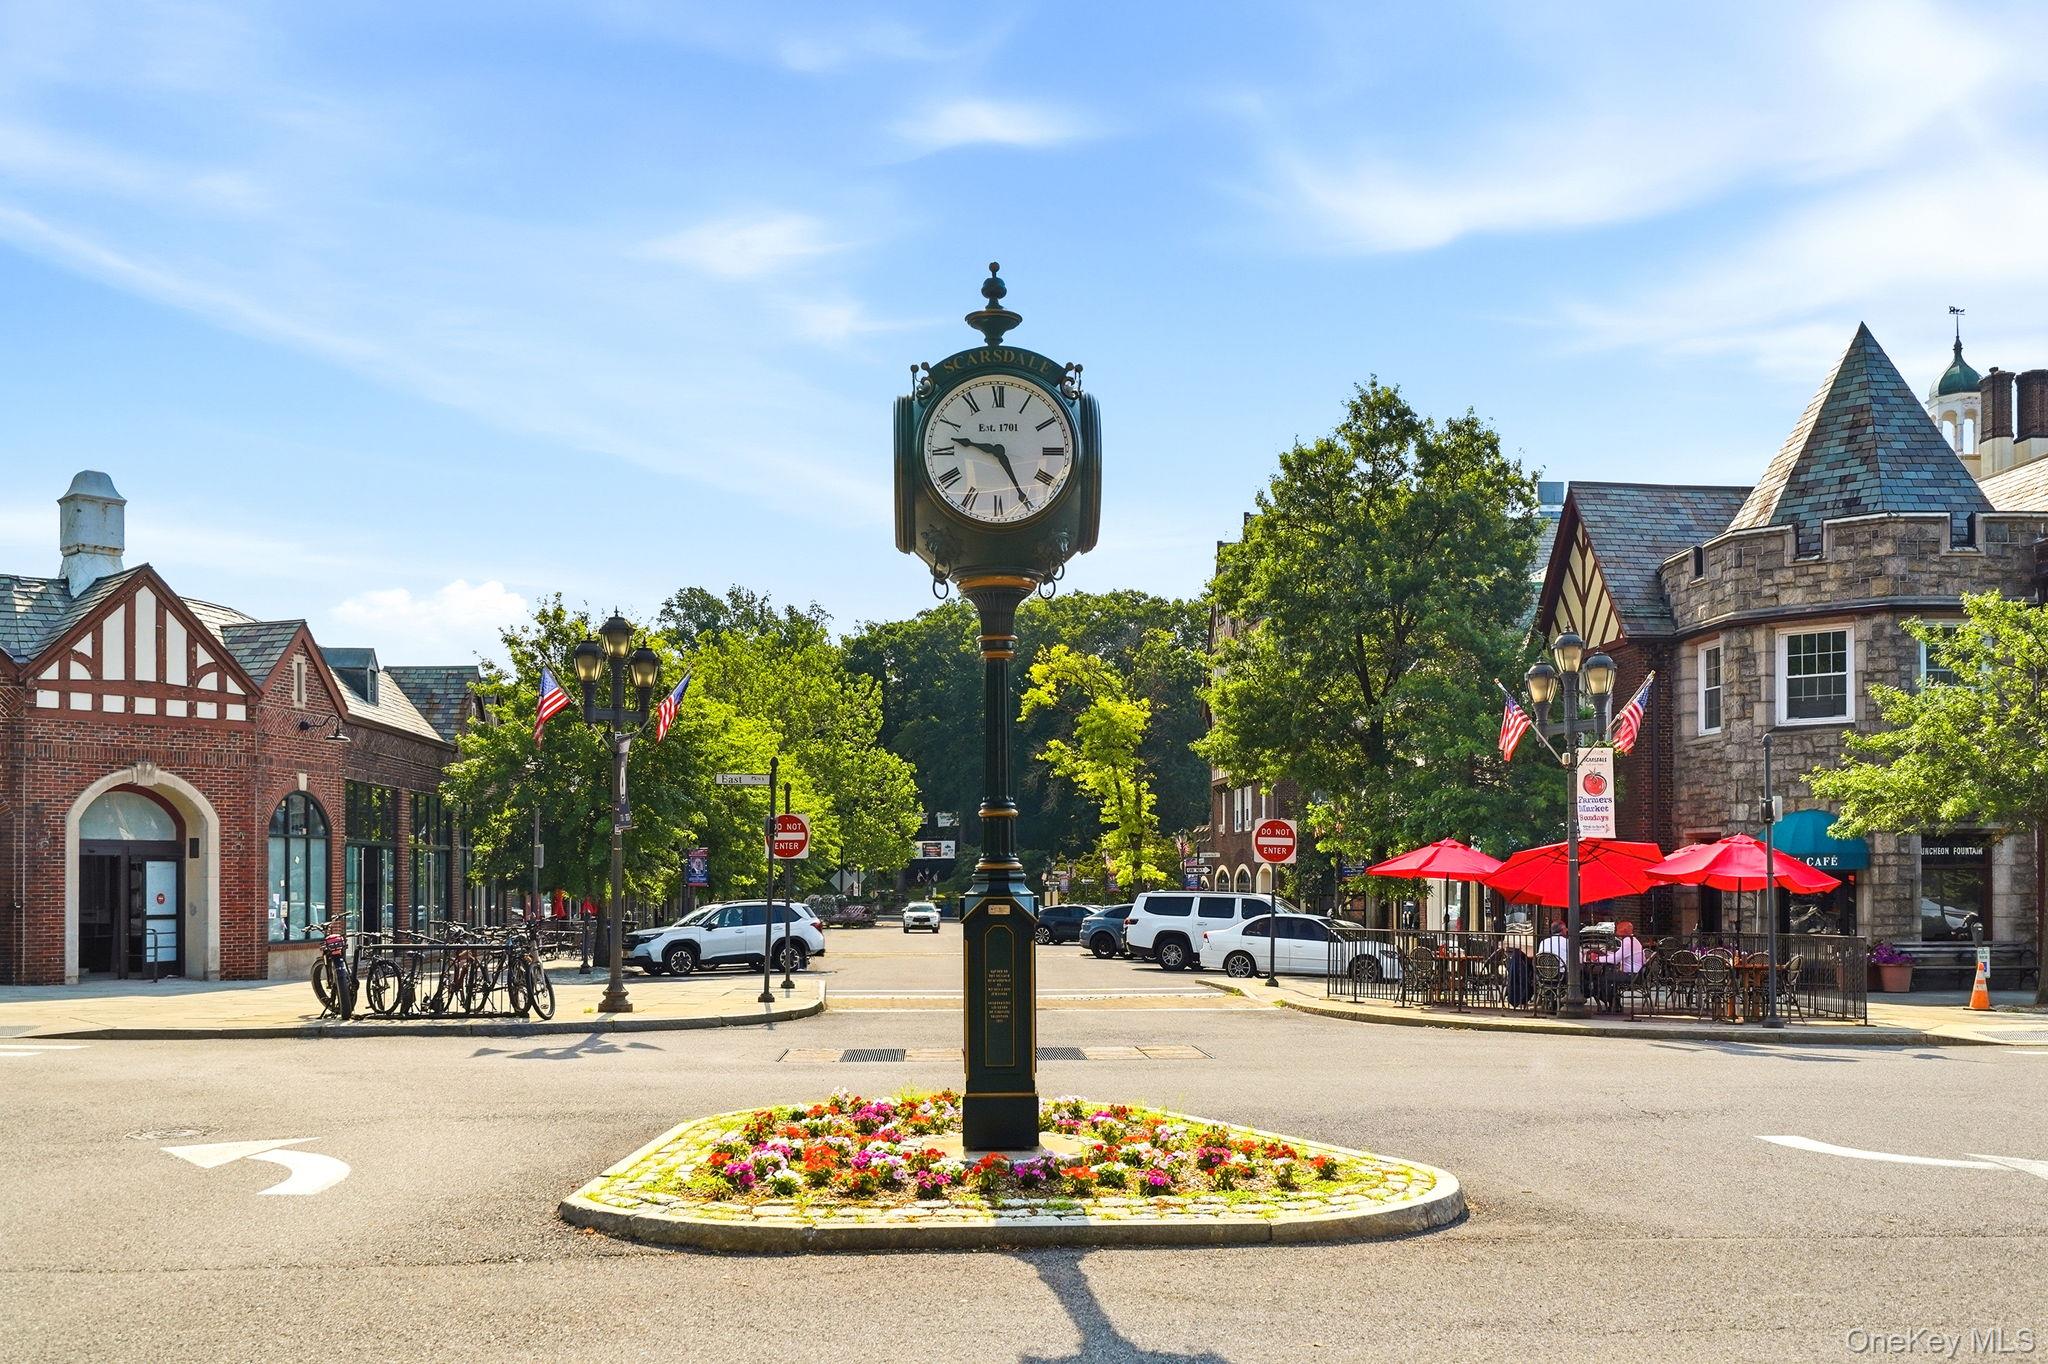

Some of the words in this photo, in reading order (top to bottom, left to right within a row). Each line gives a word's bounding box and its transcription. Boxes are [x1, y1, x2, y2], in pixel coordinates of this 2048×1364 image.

[943, 349, 1053, 374] SCARSDALE
[991, 386, 1005, 408] XII
[962, 391, 981, 416] XI
[940, 415, 962, 432] X
[978, 424, 996, 432] Est.
[999, 423, 1018, 432] 1701
[1035, 416, 1057, 432] II
[1042, 447, 1064, 456] III
[721, 775, 743, 784] East
[1578, 796, 1613, 804] Farmers
[1579, 814, 1609, 822] Sundays
[786, 823, 802, 831] NOT
[1261, 828, 1272, 836] DO
[1275, 828, 1291, 836] NOT
[774, 842, 799, 850] ENTER
[1263, 846, 1287, 855] ENTER
[1920, 847, 1950, 855] UNCHEON
[1953, 847, 1984, 855] FOUNTAIN
[1806, 855, 1838, 867] CAFÉ
